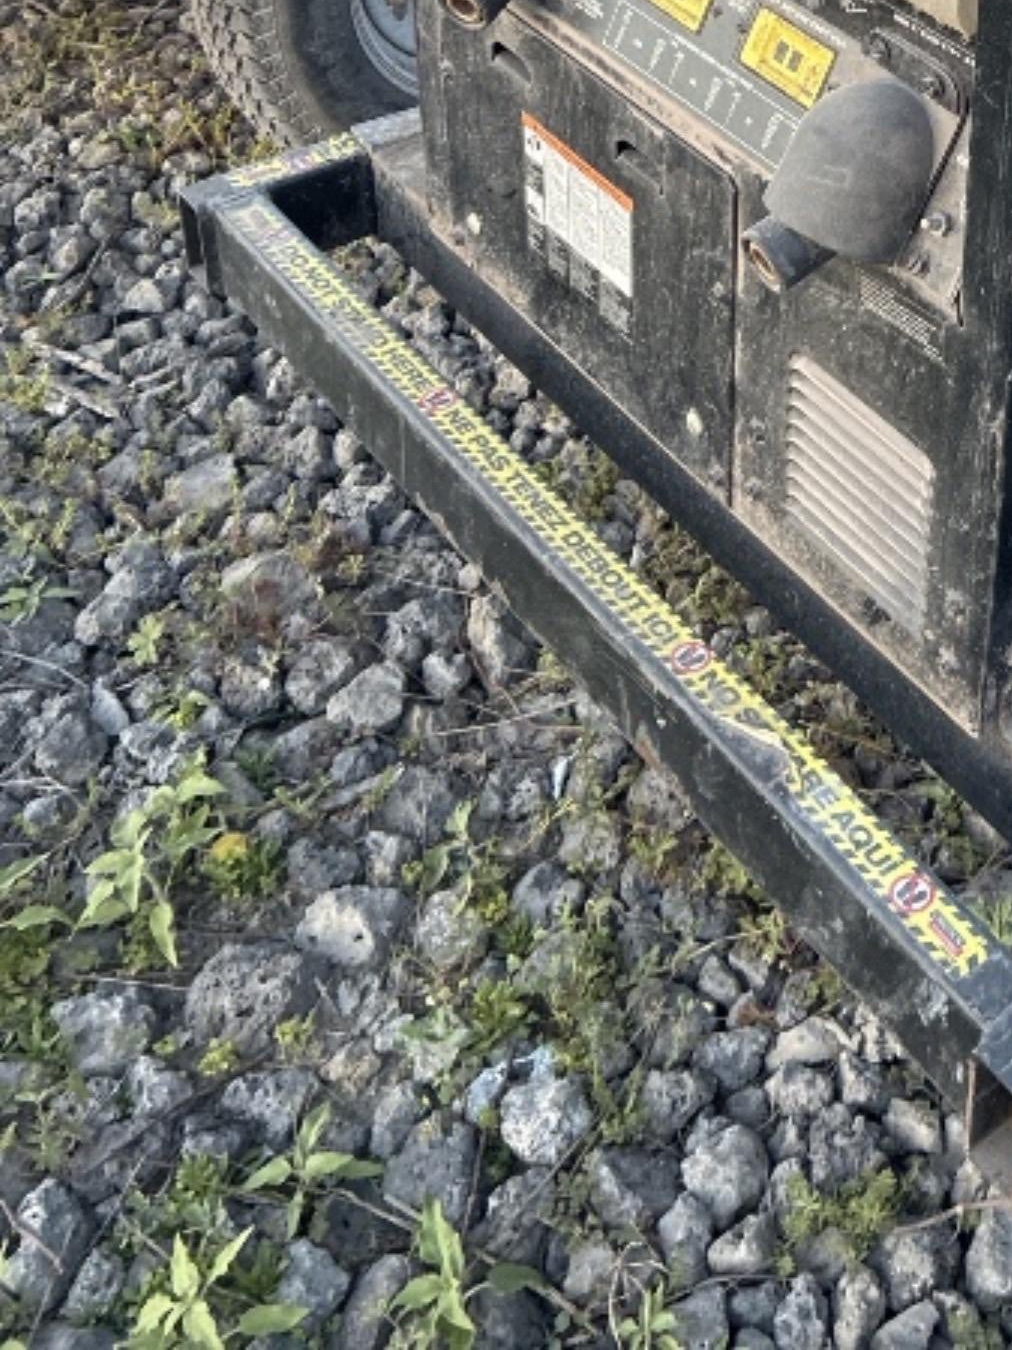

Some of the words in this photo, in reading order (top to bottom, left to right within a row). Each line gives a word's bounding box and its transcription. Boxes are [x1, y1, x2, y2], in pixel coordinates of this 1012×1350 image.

[449, 407, 477, 435] NE
[469, 434, 511, 471] PAS
[506, 470, 570, 531] TENEZ
[562, 530, 650, 611] DEBOUT
[641, 613, 679, 644] ICI
[699, 669, 741, 706] NO
